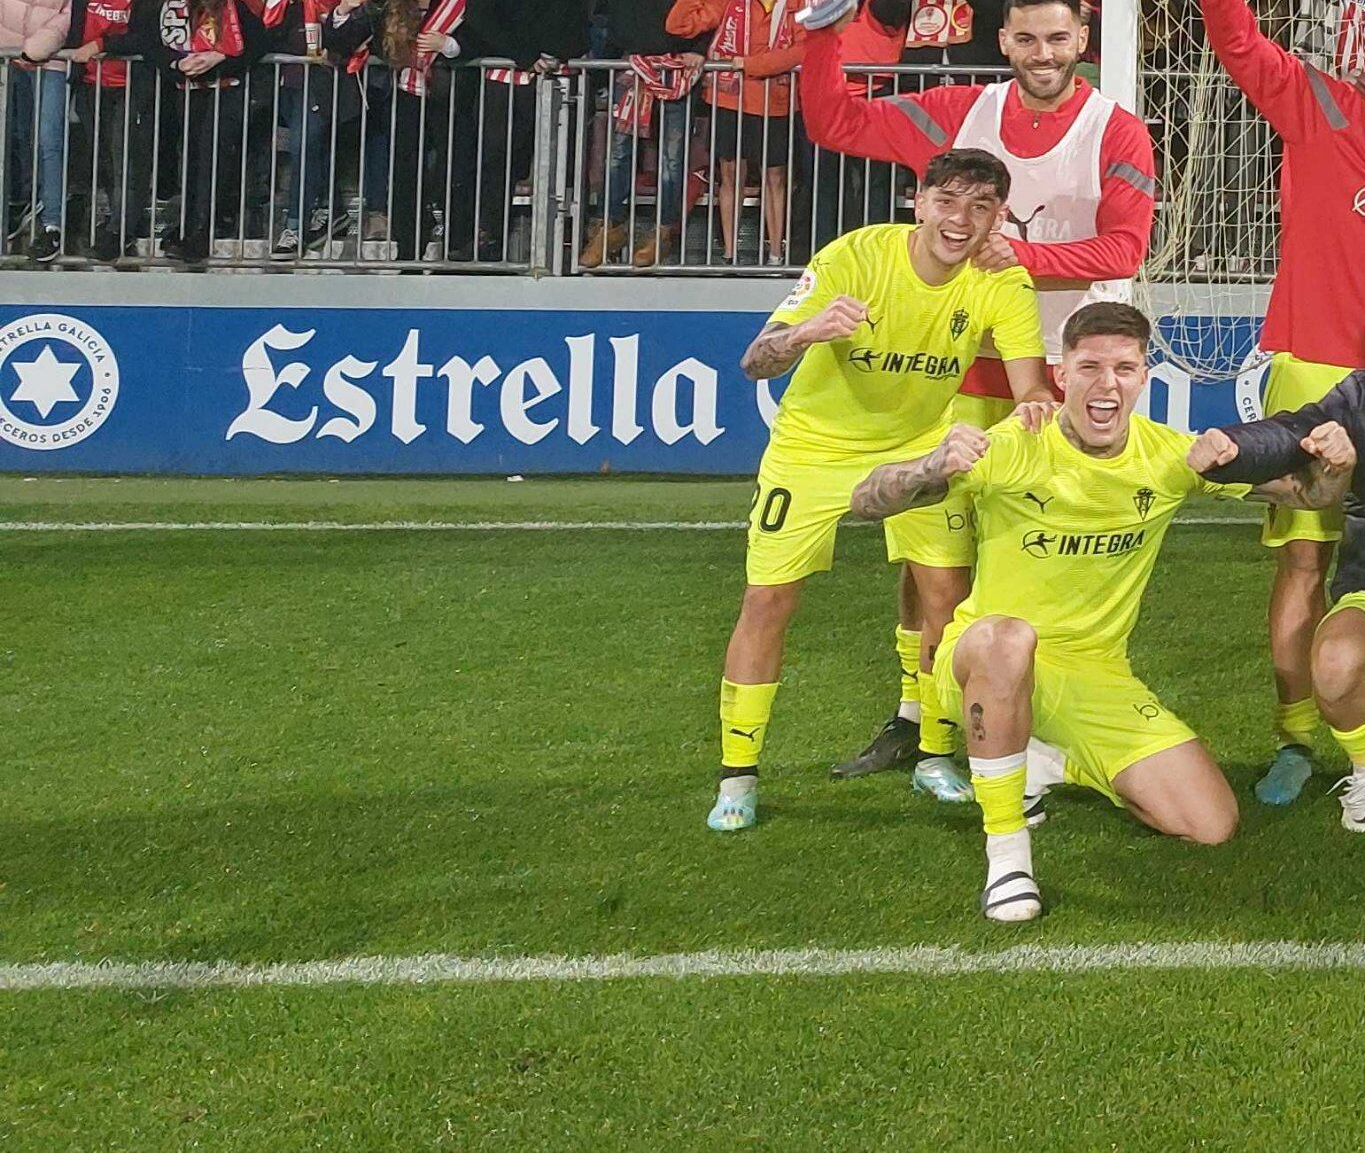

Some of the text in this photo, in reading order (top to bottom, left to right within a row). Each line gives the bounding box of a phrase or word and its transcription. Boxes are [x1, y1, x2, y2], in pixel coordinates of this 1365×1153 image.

[881, 352, 961, 376] INTEGRA
[224, 323, 727, 446] Estrella
[51, 418, 95, 446] DESDE
[1056, 528, 1147, 557] INTEGRA
